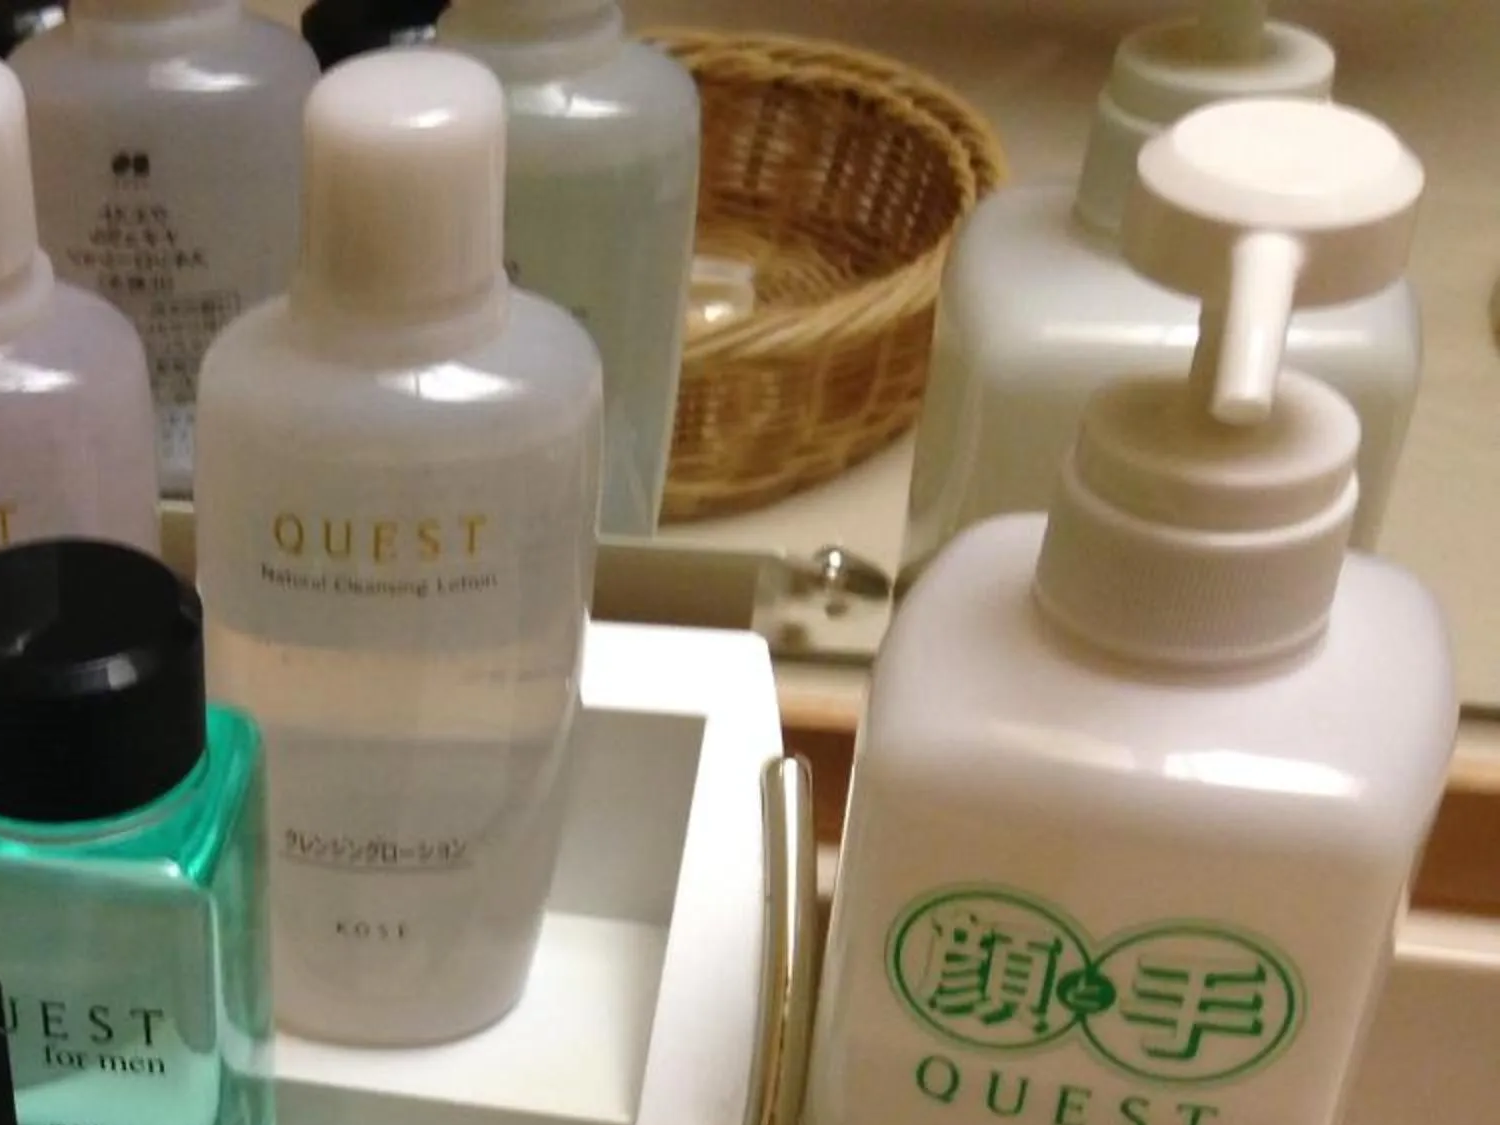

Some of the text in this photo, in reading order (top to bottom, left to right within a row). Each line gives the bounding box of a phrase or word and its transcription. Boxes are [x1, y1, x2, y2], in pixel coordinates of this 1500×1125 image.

[273, 511, 487, 563] QUEST
[261, 562, 327, 592] Natural
[44, 1045, 165, 1075] for men
